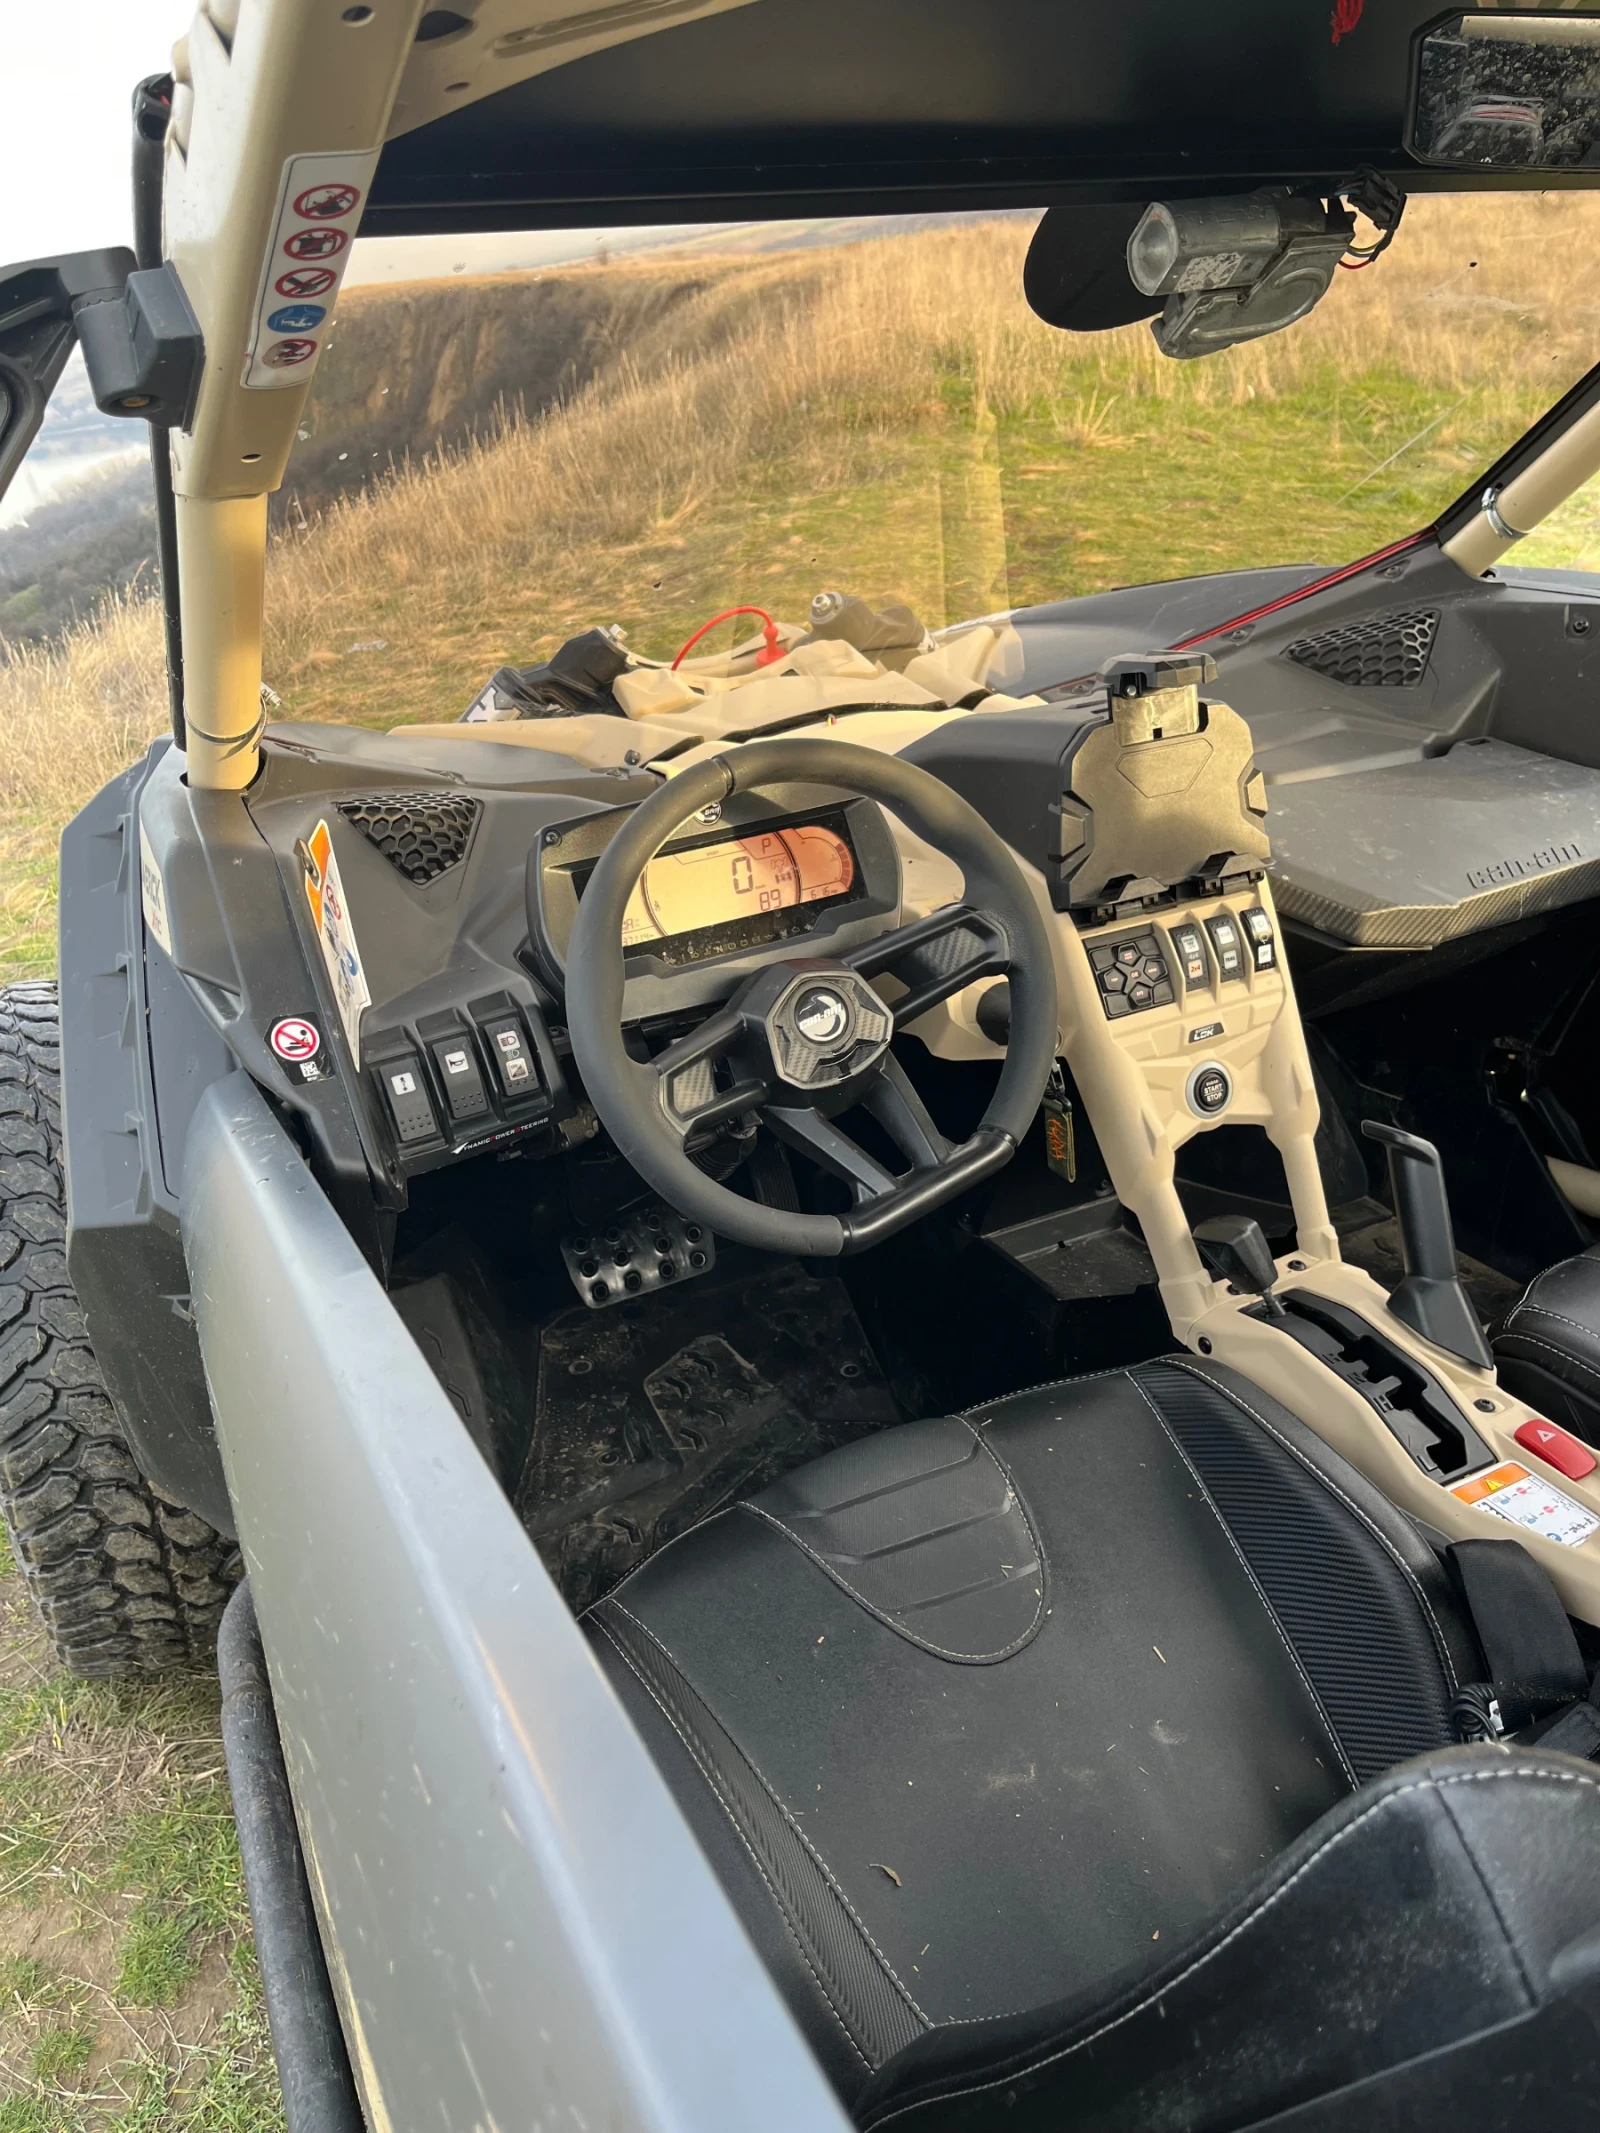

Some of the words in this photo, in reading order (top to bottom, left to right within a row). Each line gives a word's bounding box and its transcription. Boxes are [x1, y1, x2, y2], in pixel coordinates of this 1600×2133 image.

[762, 837, 772, 854] P
[731, 855, 754, 895] 0
[1466, 842, 1584, 889] can-am
[759, 888, 782, 912] 89
[1190, 964, 1201, 973] 2x4
[1204, 1083, 1223, 1095] START
[1206, 1092, 1223, 1103] STOP
[1373, 1393, 1394, 1414] H
